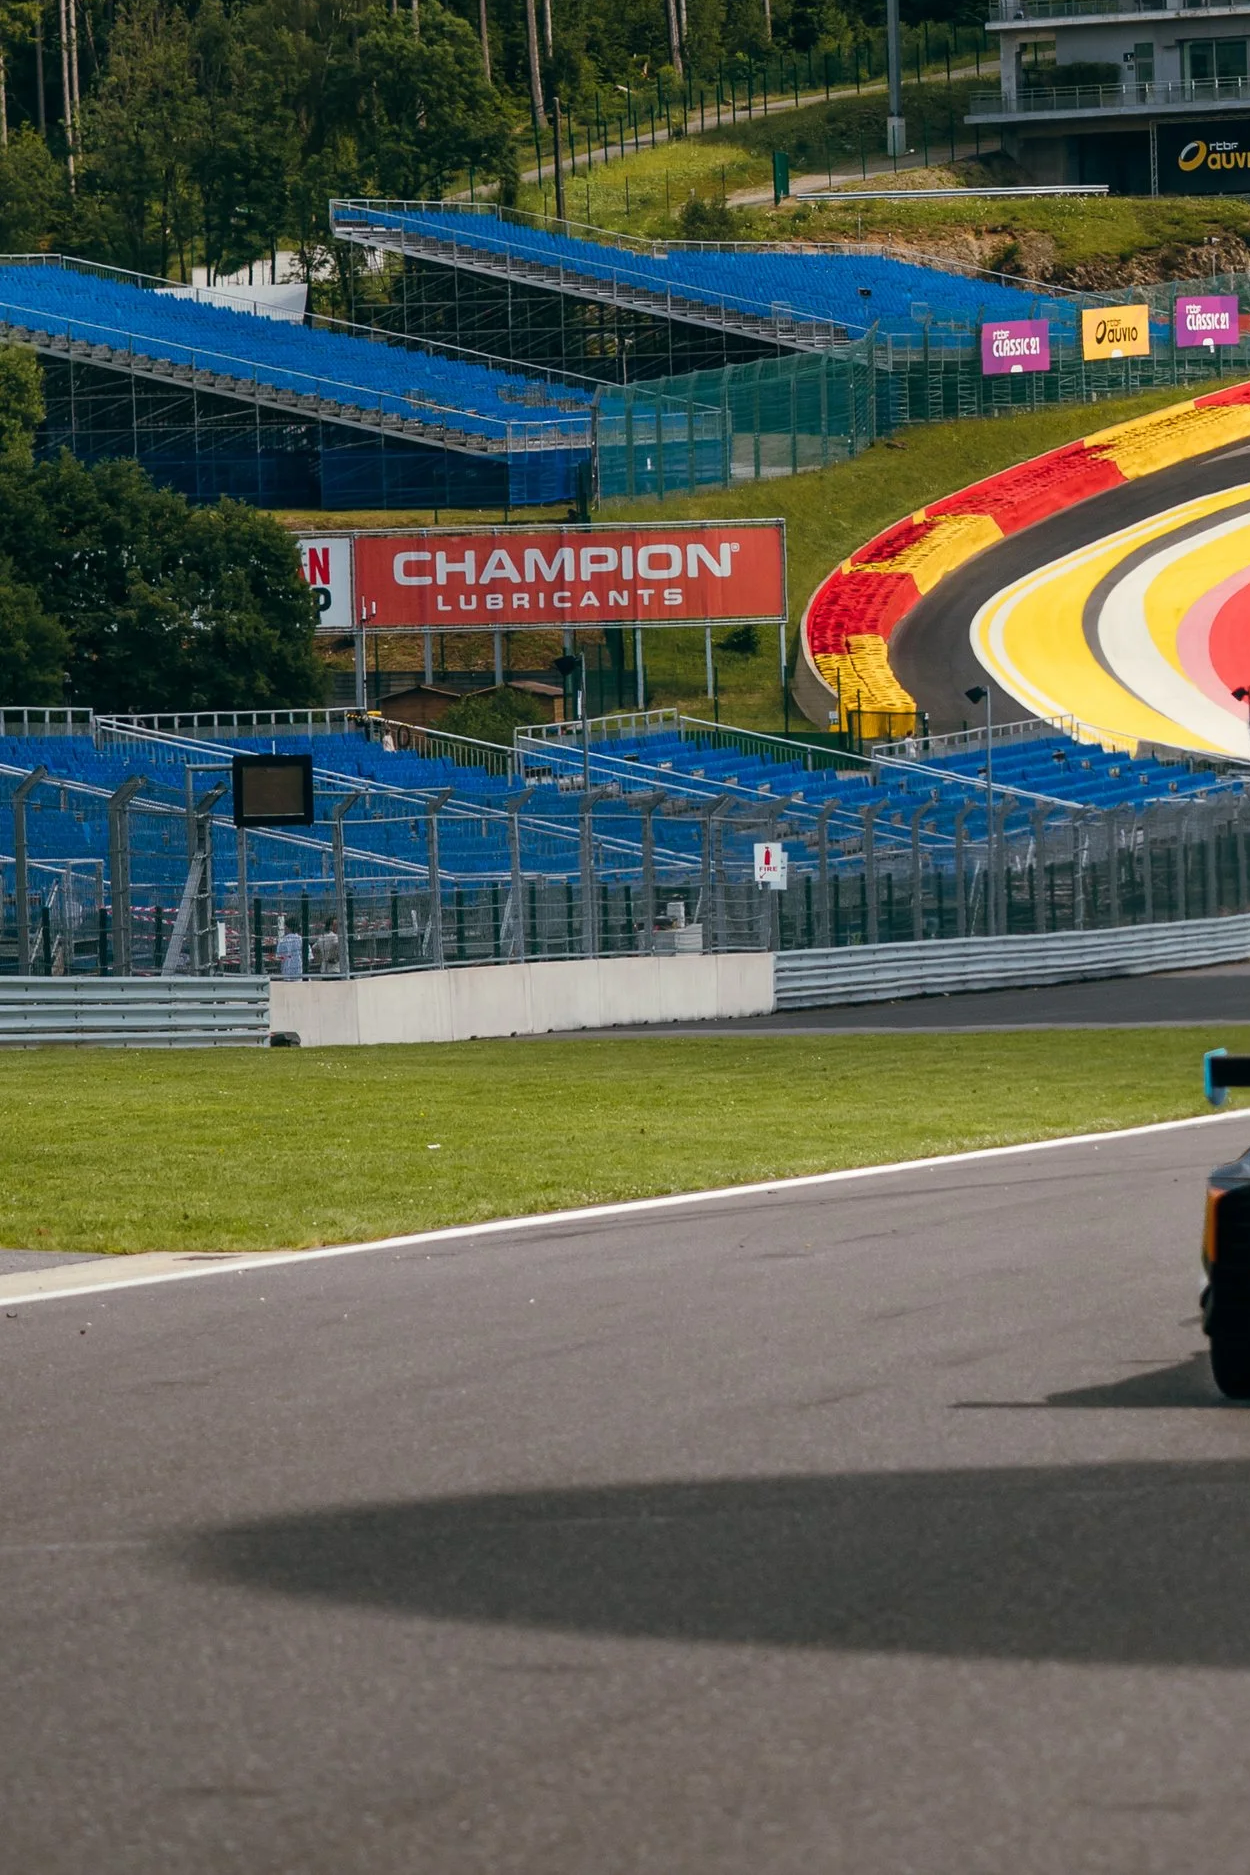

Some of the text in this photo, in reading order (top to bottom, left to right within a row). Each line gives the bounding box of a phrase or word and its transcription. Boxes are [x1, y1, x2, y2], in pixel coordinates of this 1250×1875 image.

[1209, 141, 1239, 151] rtbf
[1186, 312, 1229, 331] CLASSIC 21
[1107, 326, 1138, 343] auvio
[992, 336, 1040, 357] CLASSIC 21
[436, 588, 683, 612] LUBRICANTS
